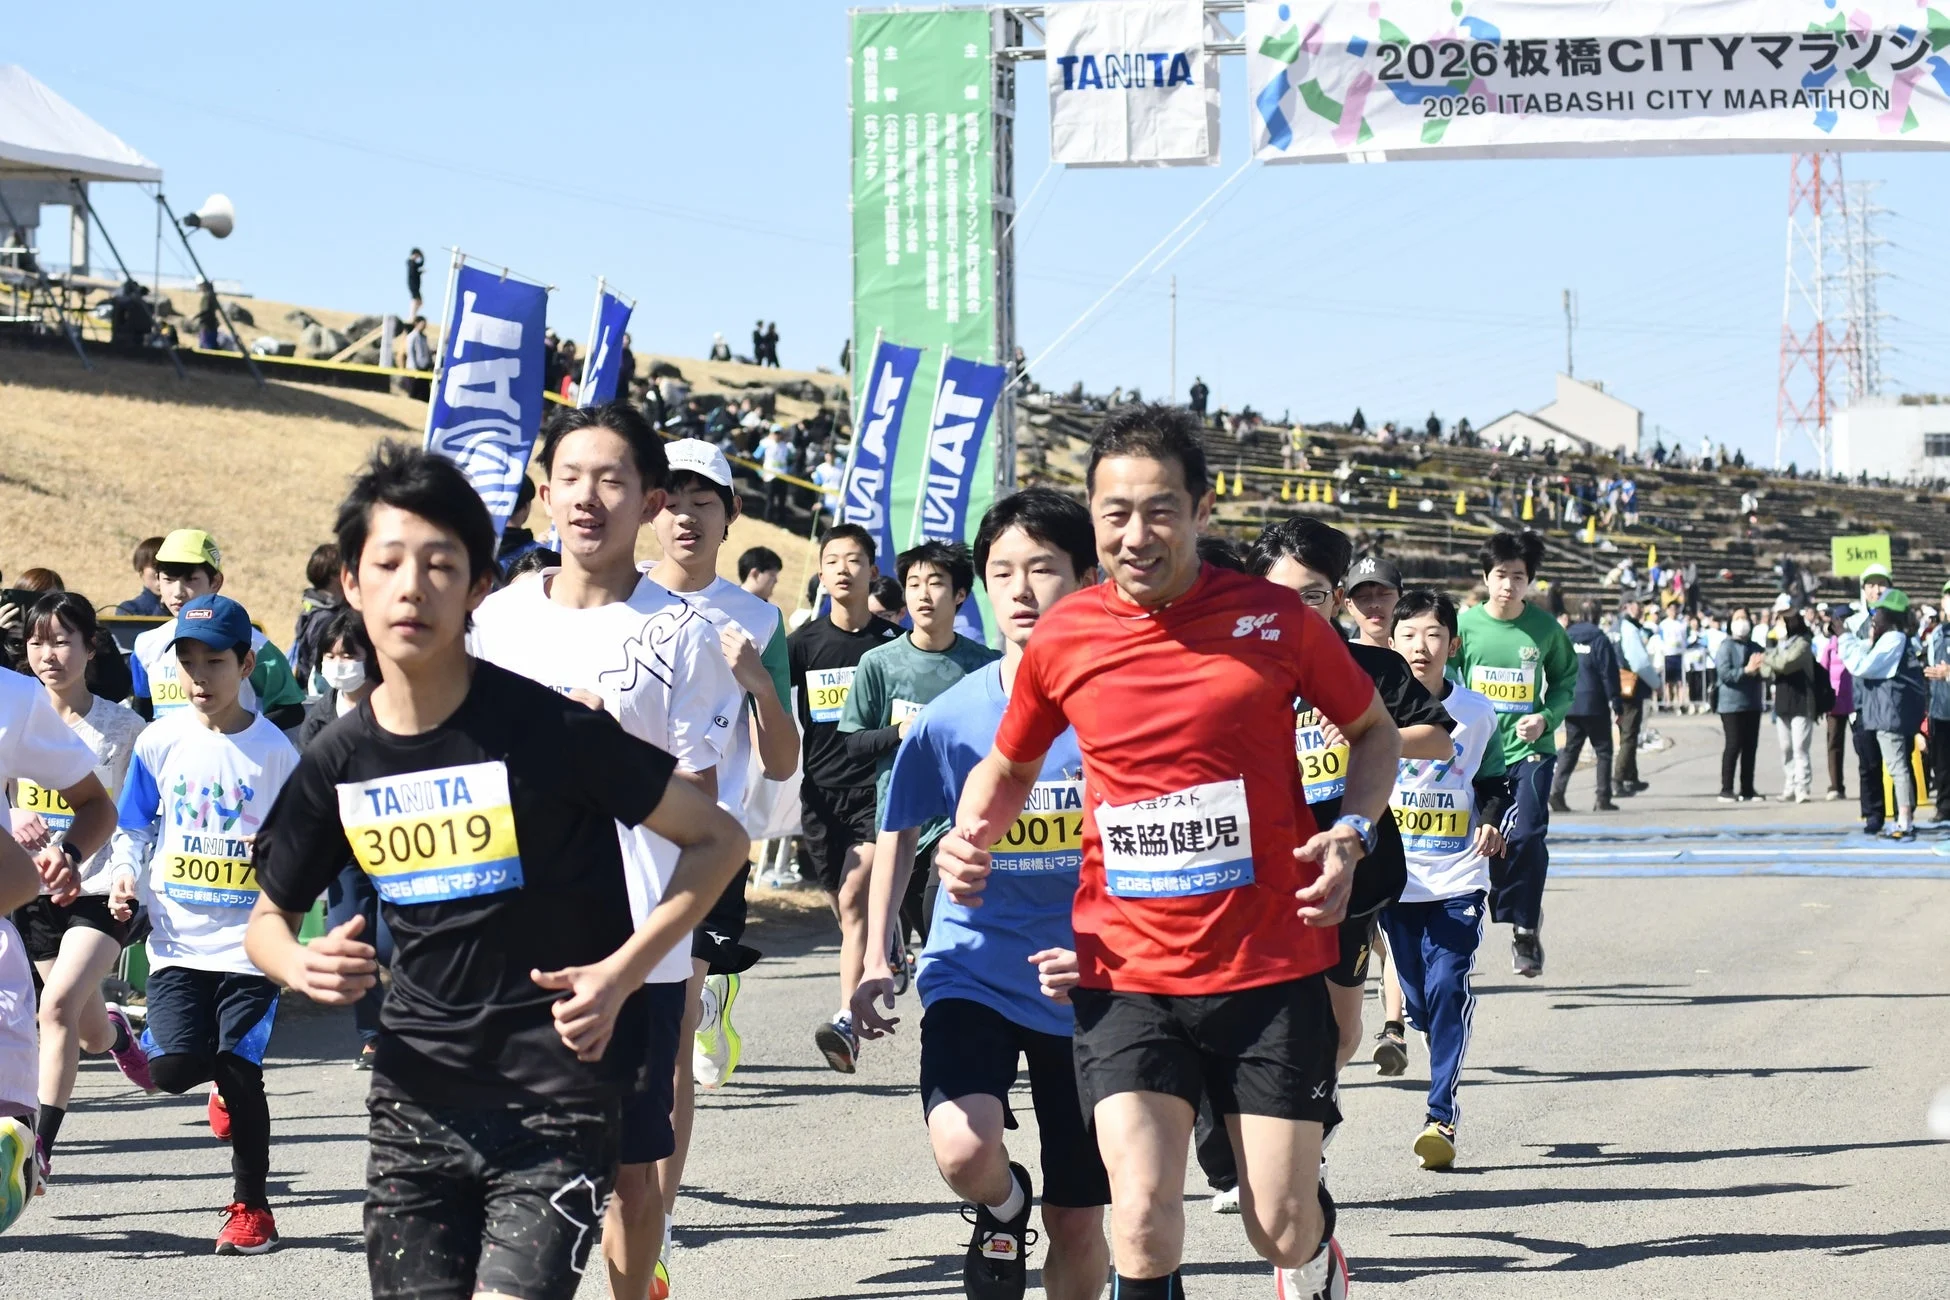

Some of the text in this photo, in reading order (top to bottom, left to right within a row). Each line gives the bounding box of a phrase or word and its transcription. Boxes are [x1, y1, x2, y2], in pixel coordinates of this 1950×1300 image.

[1057, 52, 1195, 91] TANITA
[1376, 33, 1931, 81] 2026板橋CITYマラソン
[1423, 88, 1890, 118] 2026 ITABASHI CITY MARATHON
[1846, 548, 1878, 562] 5km
[1480, 682, 1527, 699] 30013
[1485, 670, 1524, 683] TANITA
[363, 775, 473, 817] TANITA
[1400, 791, 1455, 809] TANITA
[992, 816, 1084, 846] 0014
[1392, 809, 1457, 832] 30011
[182, 834, 247, 858] TANITA
[363, 814, 492, 867] 30019
[1107, 815, 1240, 857] 森脇健児
[171, 856, 252, 885] 30017
